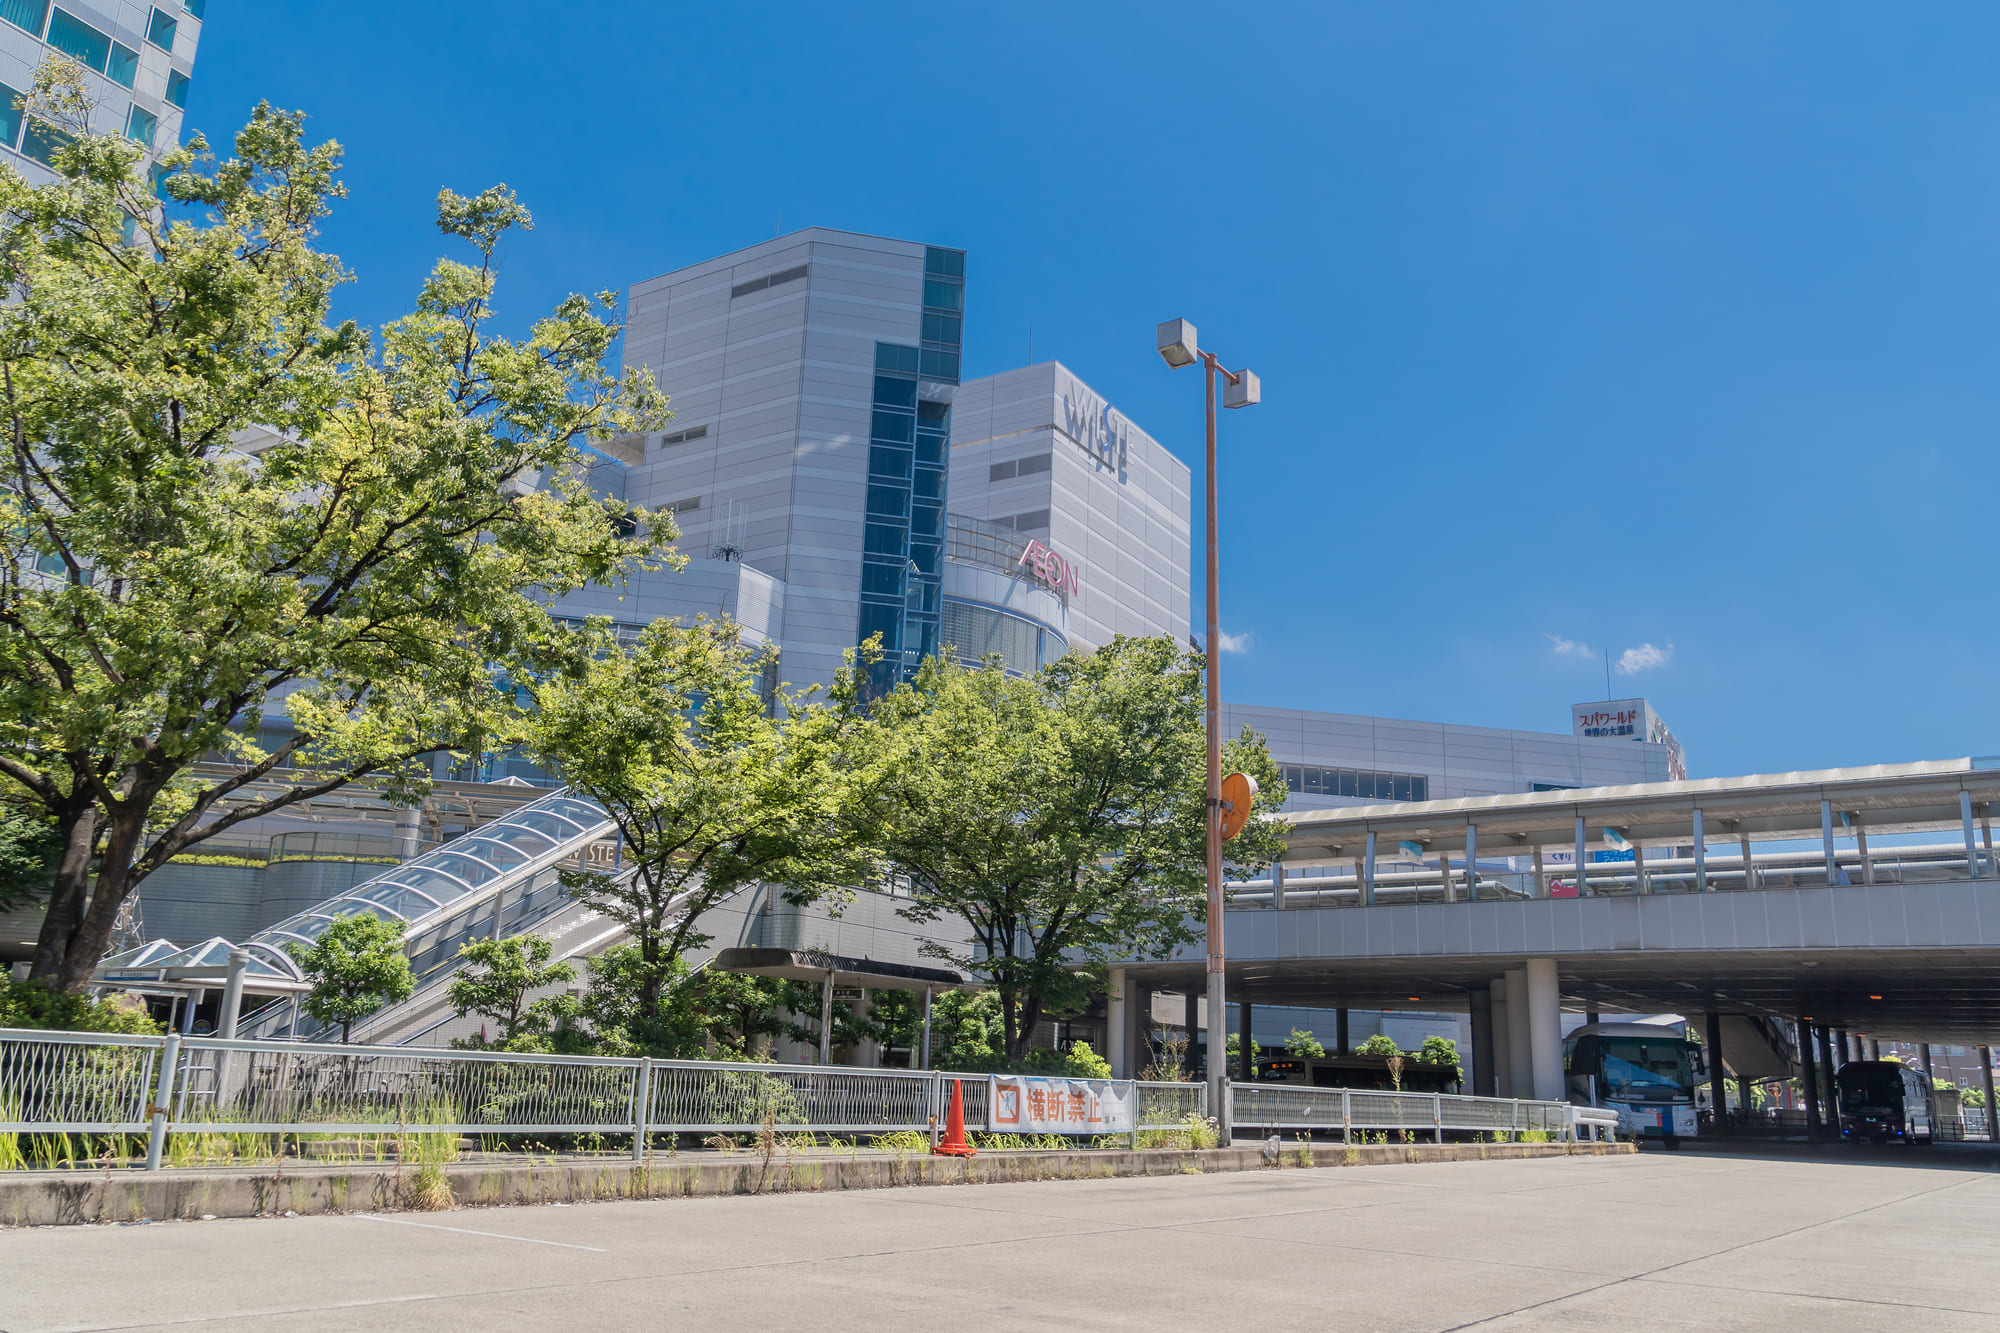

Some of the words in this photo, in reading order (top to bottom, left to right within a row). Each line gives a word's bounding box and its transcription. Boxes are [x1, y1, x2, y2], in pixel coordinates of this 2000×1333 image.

[1579, 710, 1637, 728] スパワールド
[1551, 853, 1571, 861] くすり
[1026, 1088, 1102, 1124] 横断禁止
